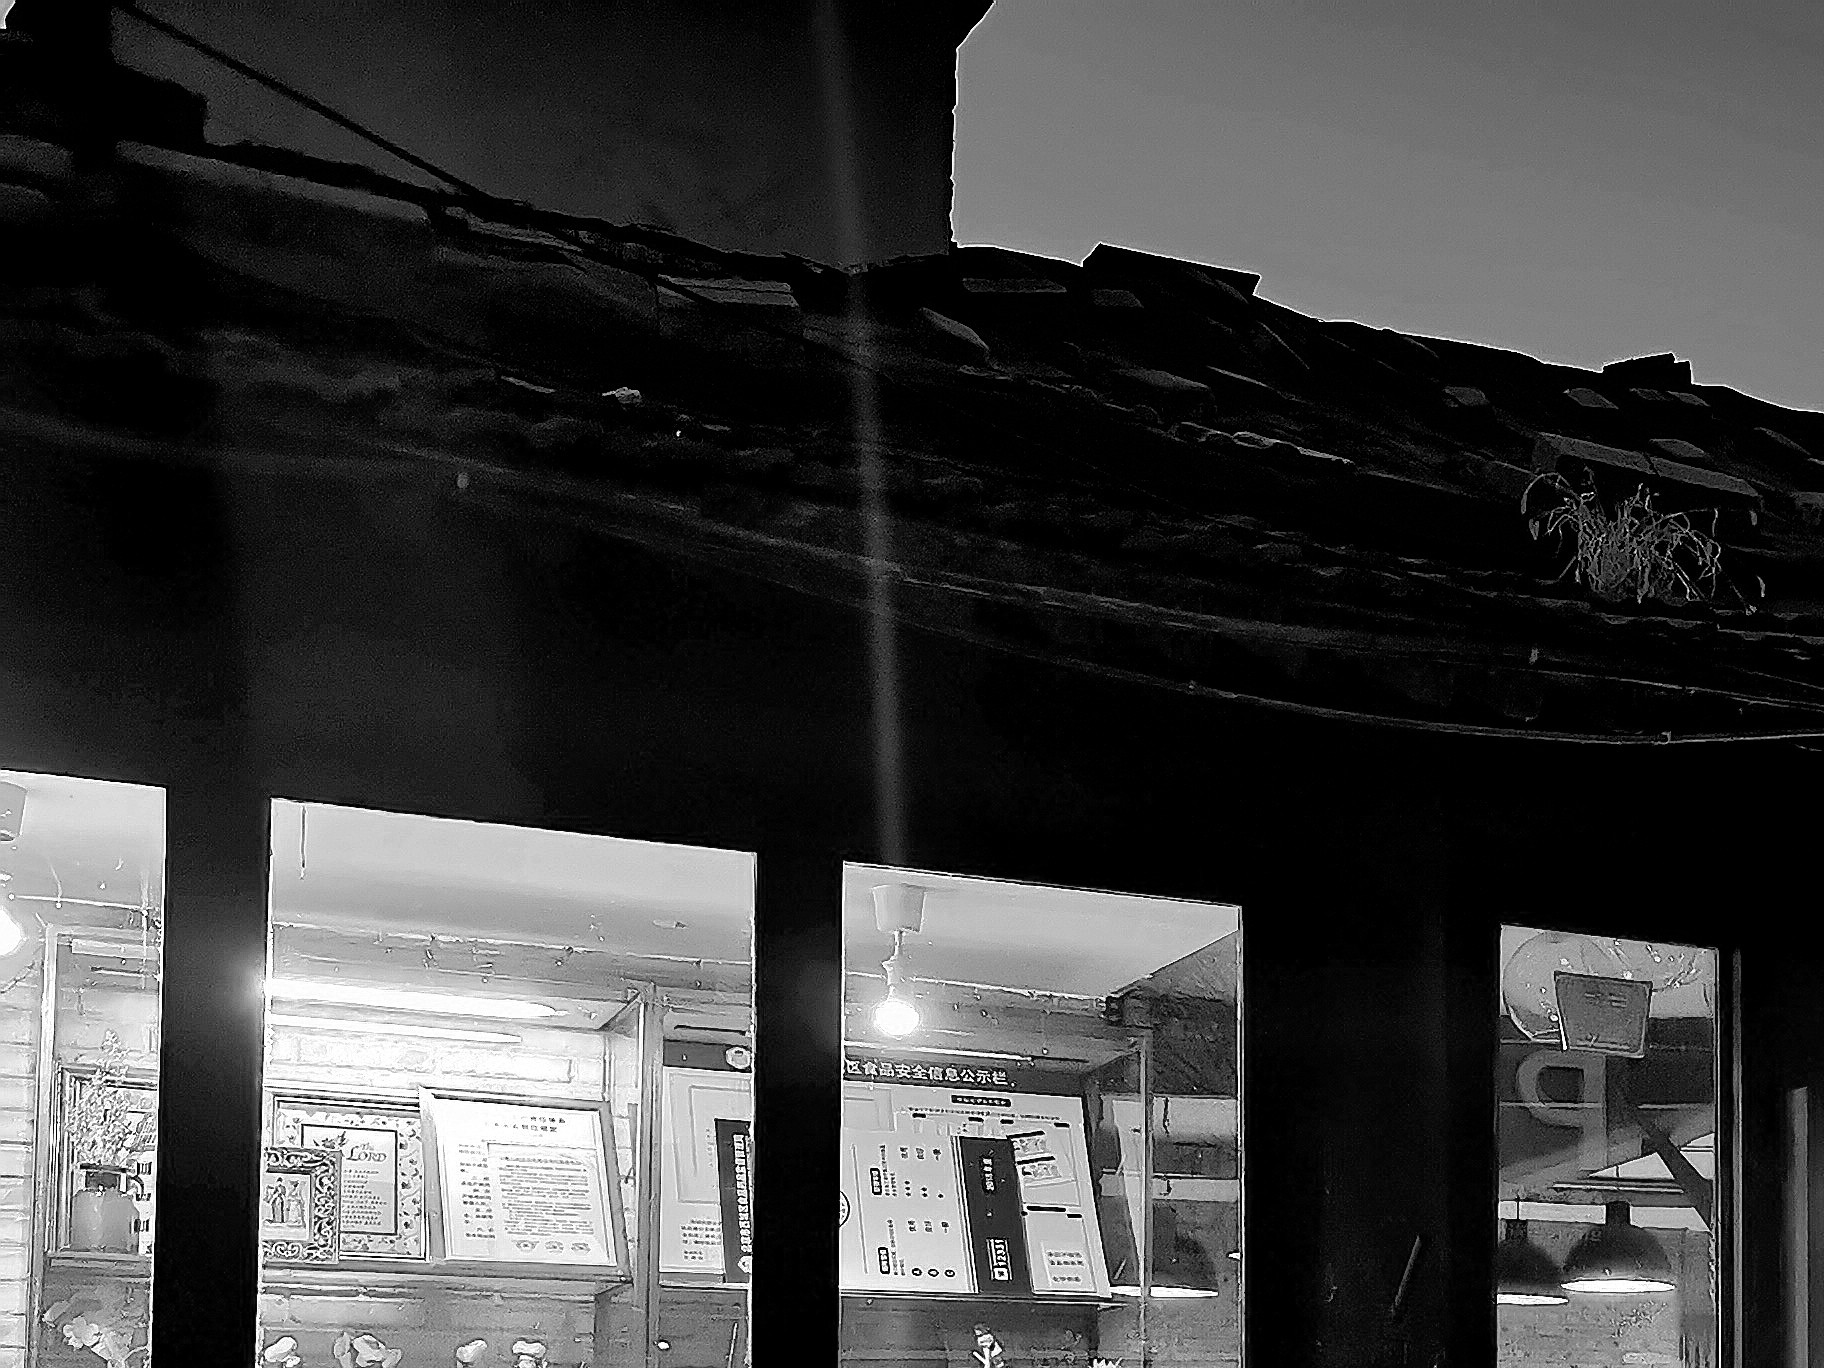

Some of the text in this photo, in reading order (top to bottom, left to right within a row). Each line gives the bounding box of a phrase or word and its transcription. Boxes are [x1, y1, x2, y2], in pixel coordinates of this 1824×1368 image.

[846, 1059, 1009, 1086] 区食品安全信息公示栏
